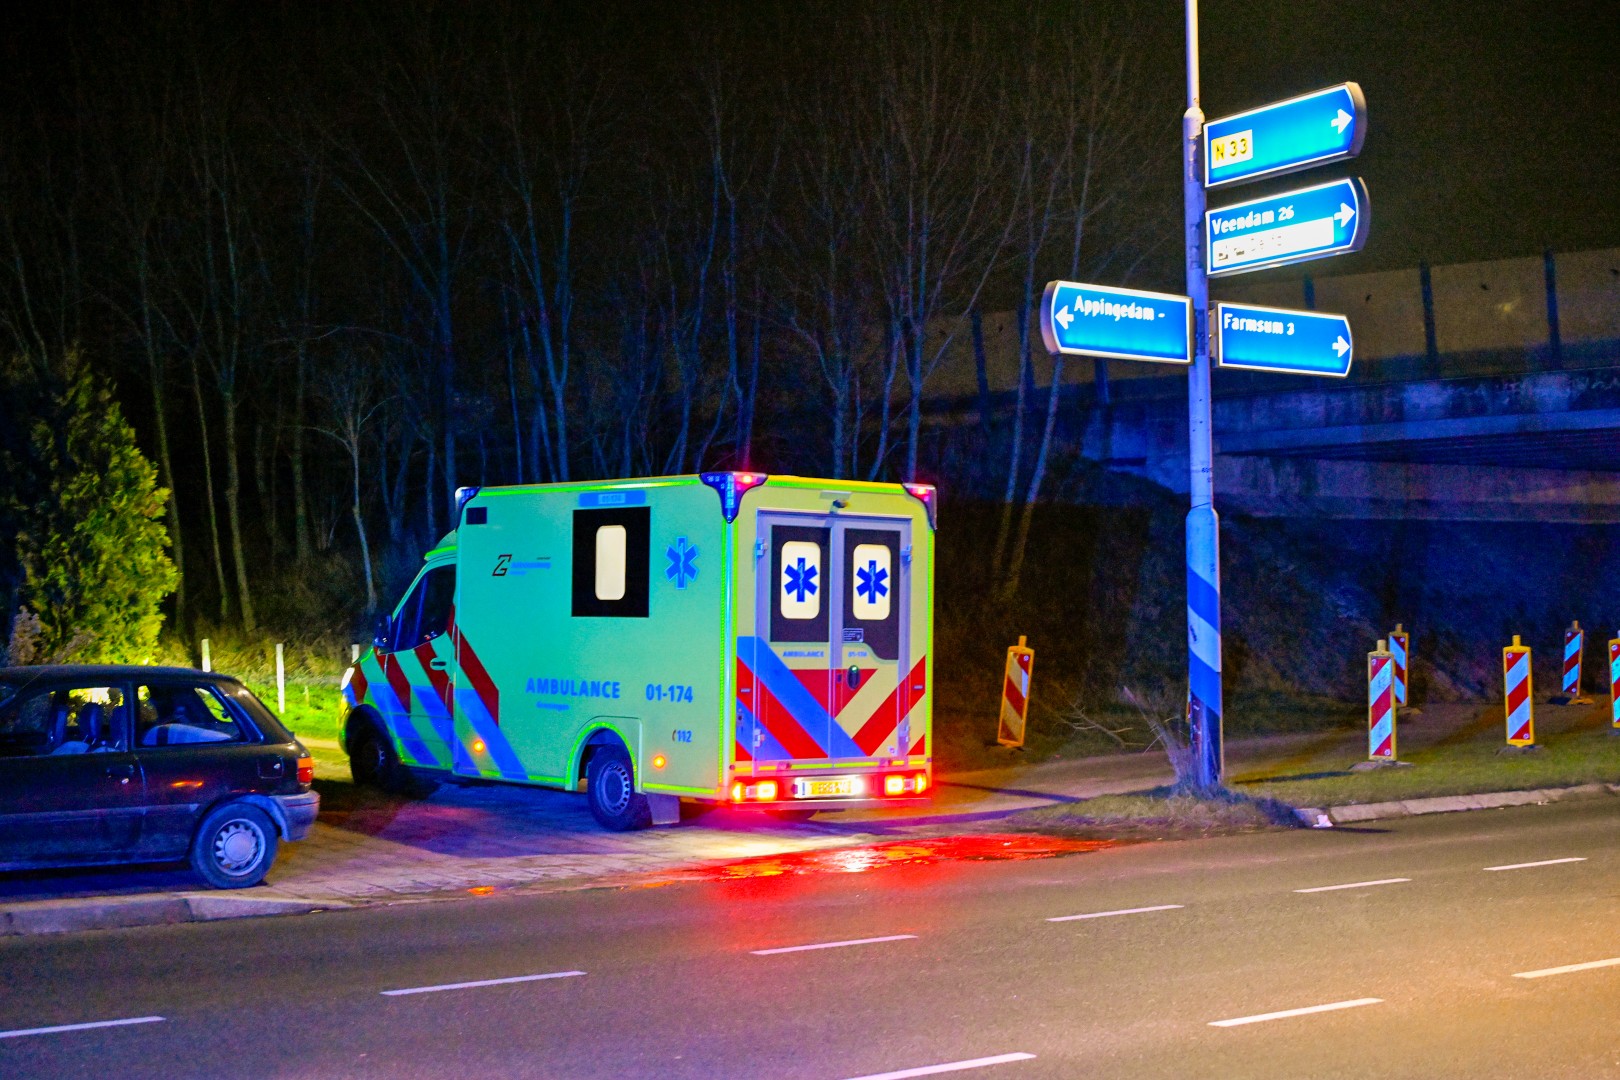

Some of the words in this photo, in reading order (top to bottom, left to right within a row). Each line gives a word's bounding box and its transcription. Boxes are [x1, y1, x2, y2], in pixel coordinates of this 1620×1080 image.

[1215, 143, 1225, 161] N
[1230, 138, 1248, 157] 33
[1212, 210, 1275, 235] Veendam
[1278, 205, 1295, 222] 26
[1073, 295, 1155, 322] Appingedam
[1223, 312, 1283, 335] Farmsum
[525, 677, 621, 699] AMBULANCE
[645, 683, 694, 703] 01-174
[676, 730, 692, 743] 112
